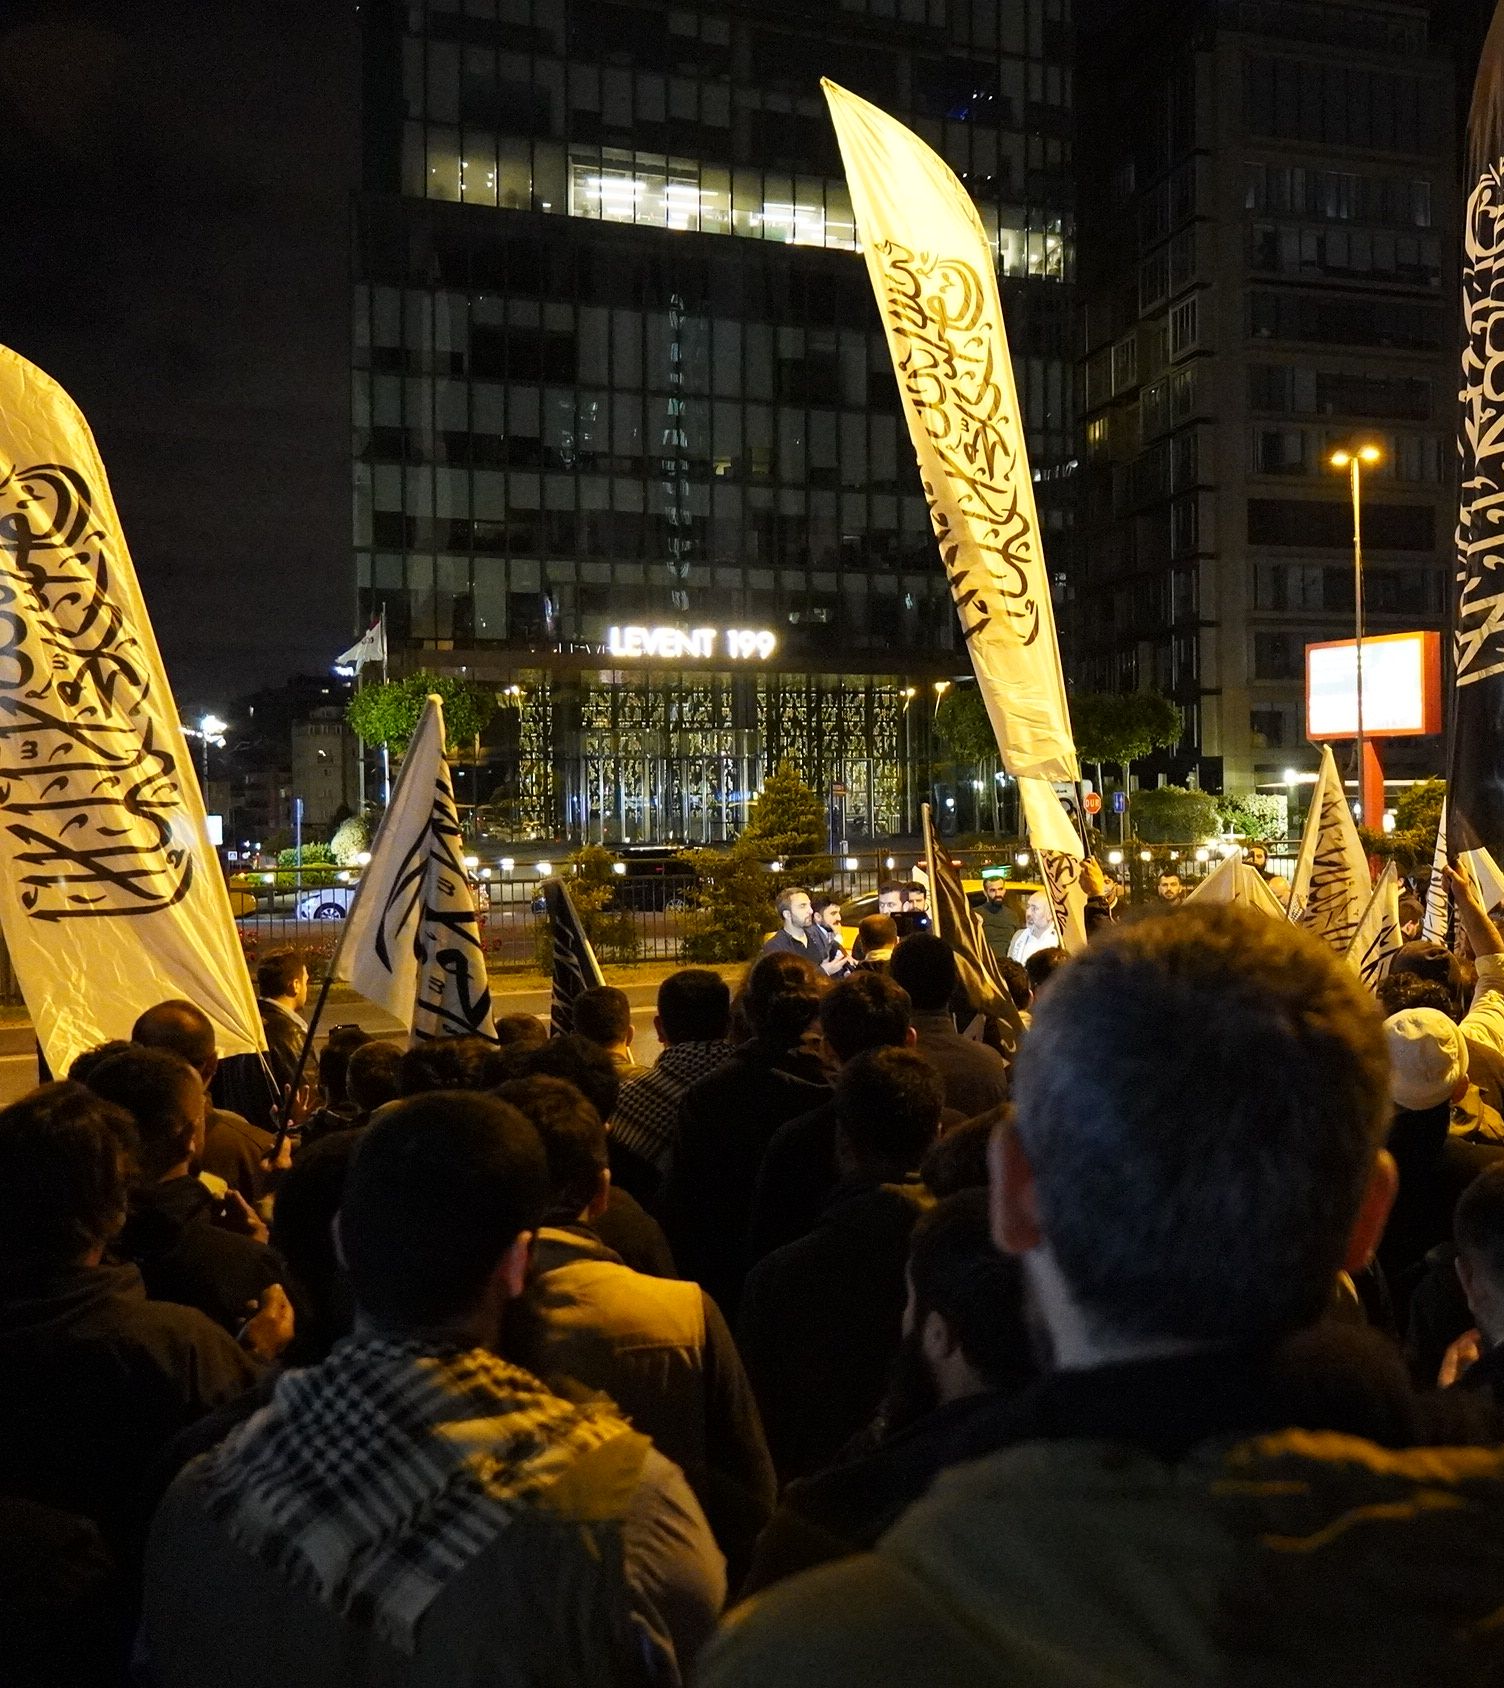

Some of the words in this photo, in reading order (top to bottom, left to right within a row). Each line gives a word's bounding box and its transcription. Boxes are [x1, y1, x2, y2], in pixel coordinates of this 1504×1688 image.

[609, 626, 717, 658] LEVENT
[727, 630, 776, 660] 199
[1085, 800, 1100, 808] DUR
